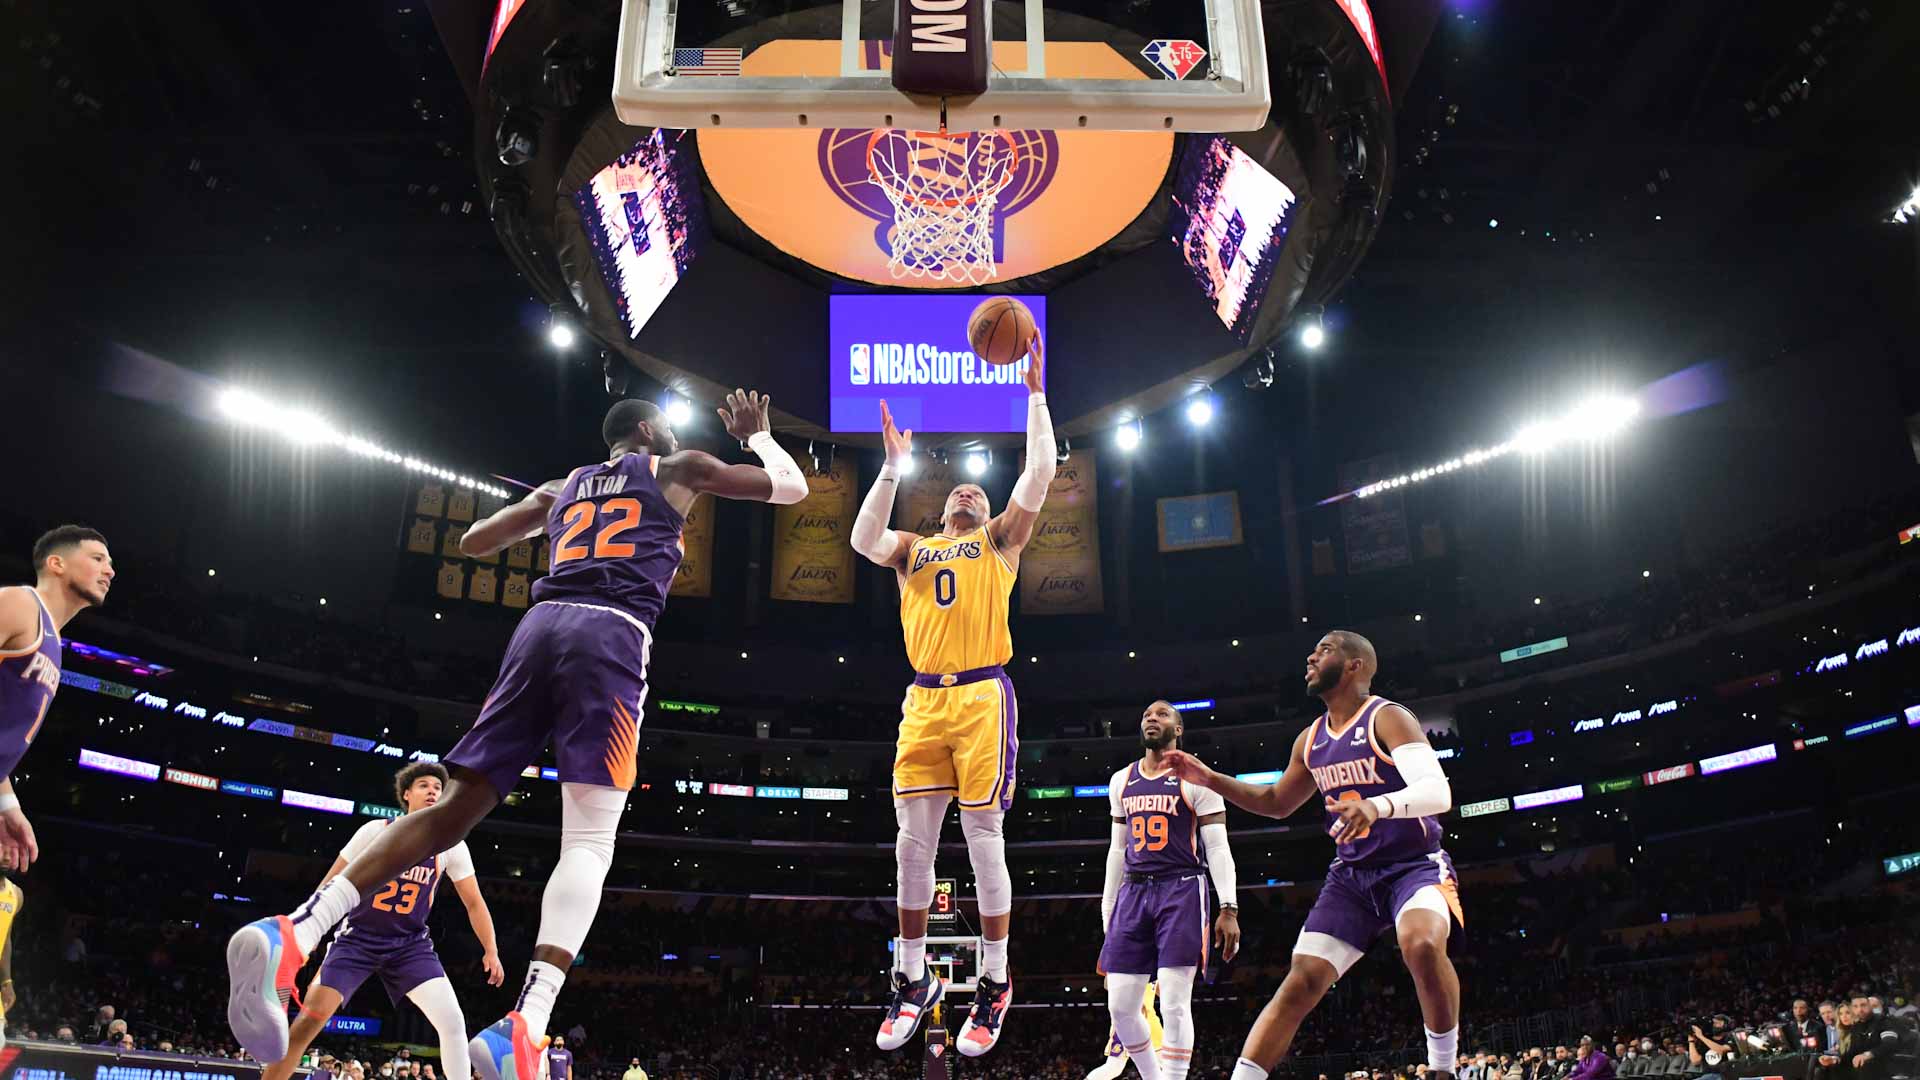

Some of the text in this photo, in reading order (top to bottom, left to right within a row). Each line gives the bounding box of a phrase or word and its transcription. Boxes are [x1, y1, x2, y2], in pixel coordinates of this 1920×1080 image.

[1179, 46, 1192, 60] 75
[576, 474, 629, 501] AYTON
[554, 497, 643, 566] 22
[911, 541, 982, 575] LAKERS
[934, 568, 957, 609] 0
[1805, 735, 1829, 746] TOYOTA
[166, 769, 219, 790] TOSHIBA
[1311, 757, 1386, 792] PHOENIX
[251, 786, 273, 798] ULTRA
[767, 788, 800, 797] DELTA
[804, 789, 848, 799] STAPLES
[1121, 794, 1181, 816] PHOENIX
[1462, 799, 1508, 817] STAPLES
[1130, 815, 1169, 853] 99
[400, 865, 436, 885] ENIX
[371, 879, 421, 915] 23
[937, 893, 949, 912] 9
[337, 1017, 366, 1031] ULTRA
